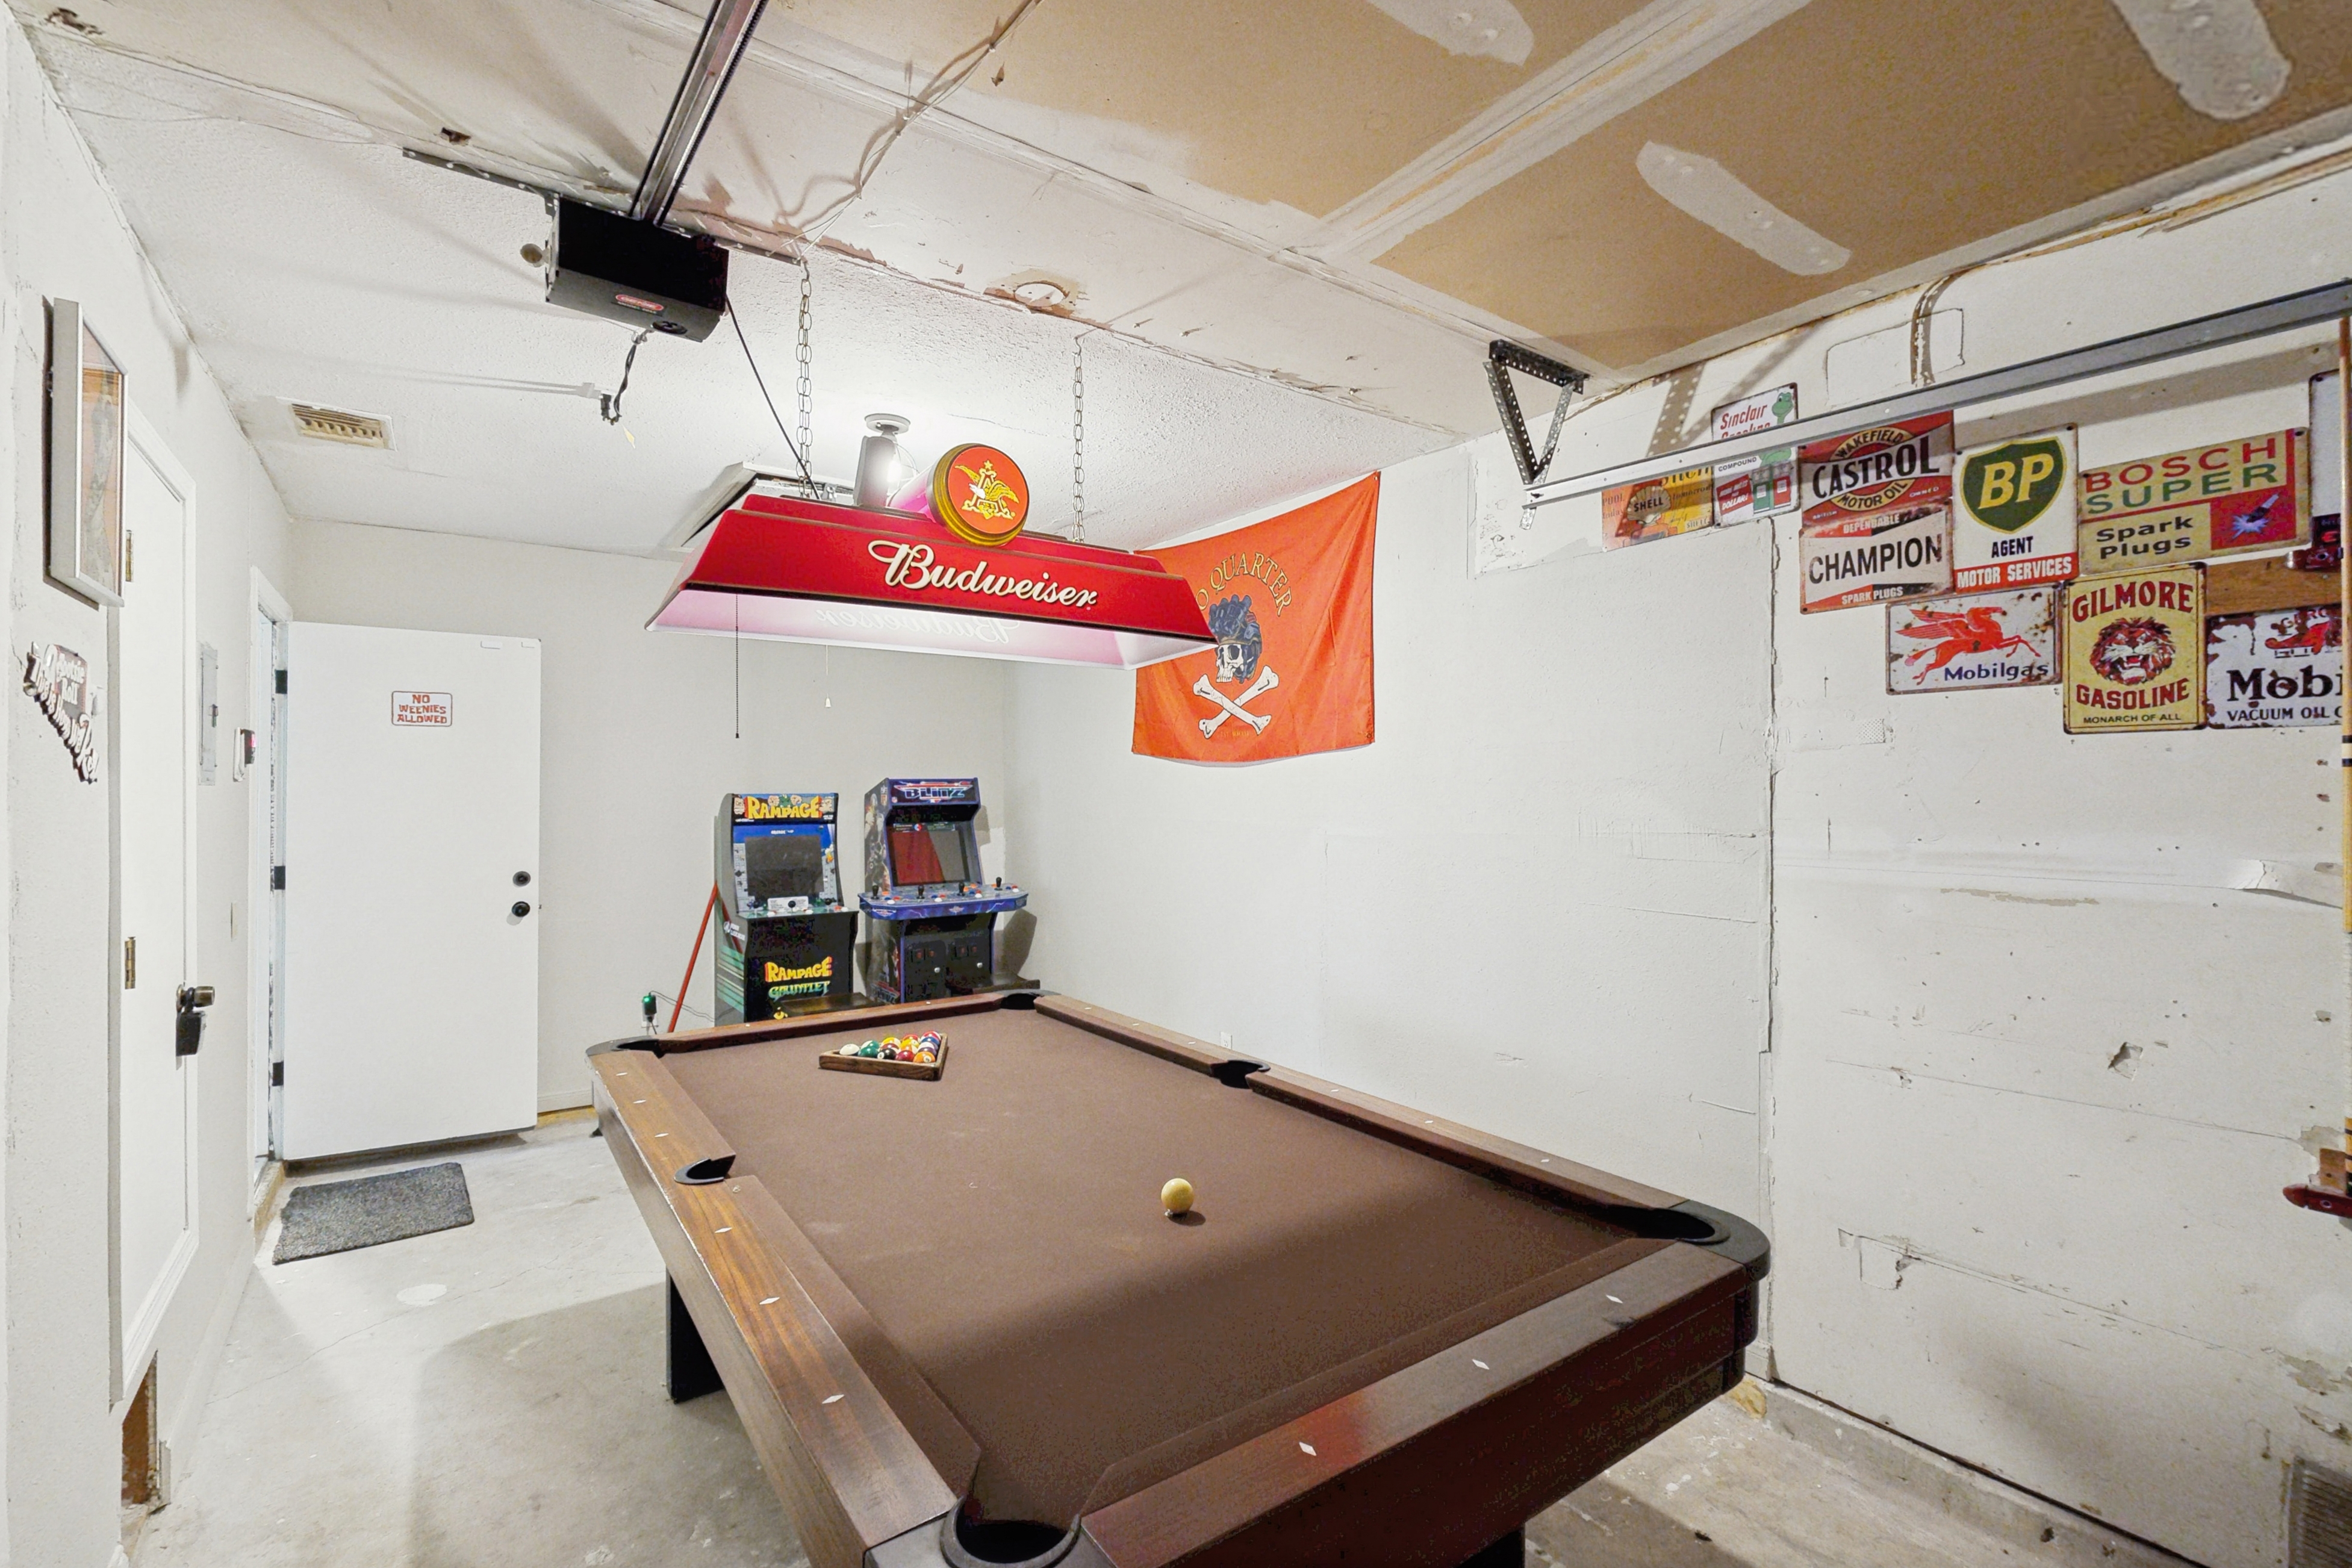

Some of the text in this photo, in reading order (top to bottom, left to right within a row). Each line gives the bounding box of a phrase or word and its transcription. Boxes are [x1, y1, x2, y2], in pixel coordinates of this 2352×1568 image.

[1720, 405, 1767, 430] Sinclair
[1835, 429, 1904, 458] WAKEFIELD
[1718, 456, 1757, 472] COMPOUND
[1812, 435, 1940, 499] CASTROL
[2086, 438, 2276, 493] BOSCH
[1977, 453, 2054, 509] BP
[2086, 463, 2278, 514] SUPER
[1634, 497, 1664, 512] SHELL
[1837, 482, 1908, 509] MOTOR OIL
[1843, 514, 1900, 534] DEPENDABLE
[2097, 516, 2194, 542] Spark
[1809, 534, 1943, 584] CHAMPION
[1991, 536, 2033, 558] AGENT
[2100, 537, 2192, 559] Plugs
[868, 540, 1098, 608] Budweiser
[1210, 552, 1293, 617] QUARTER
[1957, 556, 2072, 588] MOTOR SERVICES
[1841, 586, 1903, 605] SPARK PLUGS
[2072, 581, 2194, 623] GILMORE
[1944, 662, 2049, 681] Mobilgas
[412, 694, 430, 704] NO
[2076, 677, 2189, 710] GASOLINE
[397, 714, 447, 723] ALLOWED
[399, 705, 446, 714] WEENIES
[2083, 715, 2138, 724] MONARCH
[2227, 708, 2293, 721] VACUUM
[2301, 707, 2330, 718] OIL
[744, 795, 823, 820] RAMPAGE
[765, 956, 833, 983] RAMPAGE
[768, 981, 830, 1002] GAUNTLET
